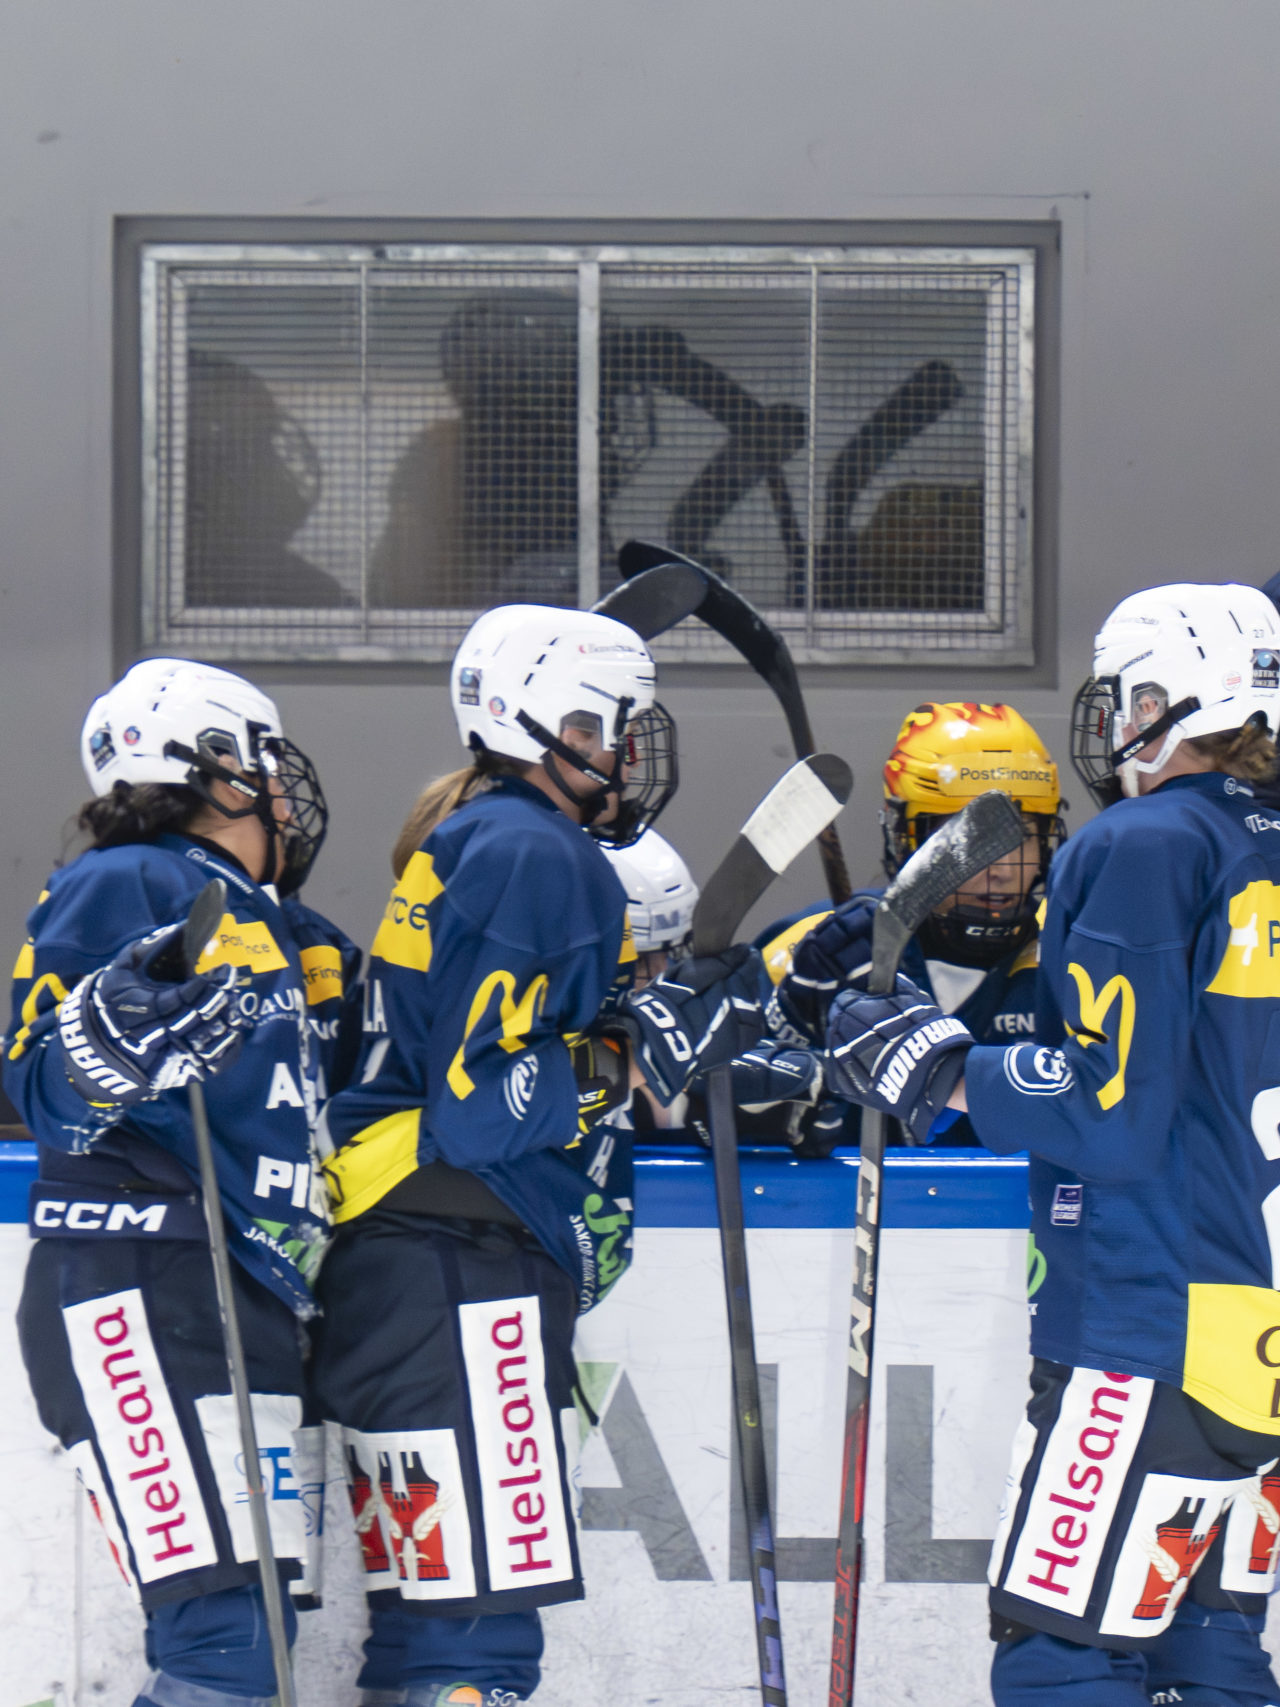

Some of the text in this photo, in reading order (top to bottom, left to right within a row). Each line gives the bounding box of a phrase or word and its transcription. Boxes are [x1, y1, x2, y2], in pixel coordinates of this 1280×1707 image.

[960, 767, 1051, 783] PostFinance
[265, 1062, 305, 1110] A
[34, 1200, 168, 1233] CCM
[93, 1305, 194, 1563] Helsana
[490, 1310, 553, 1574] Helsana
